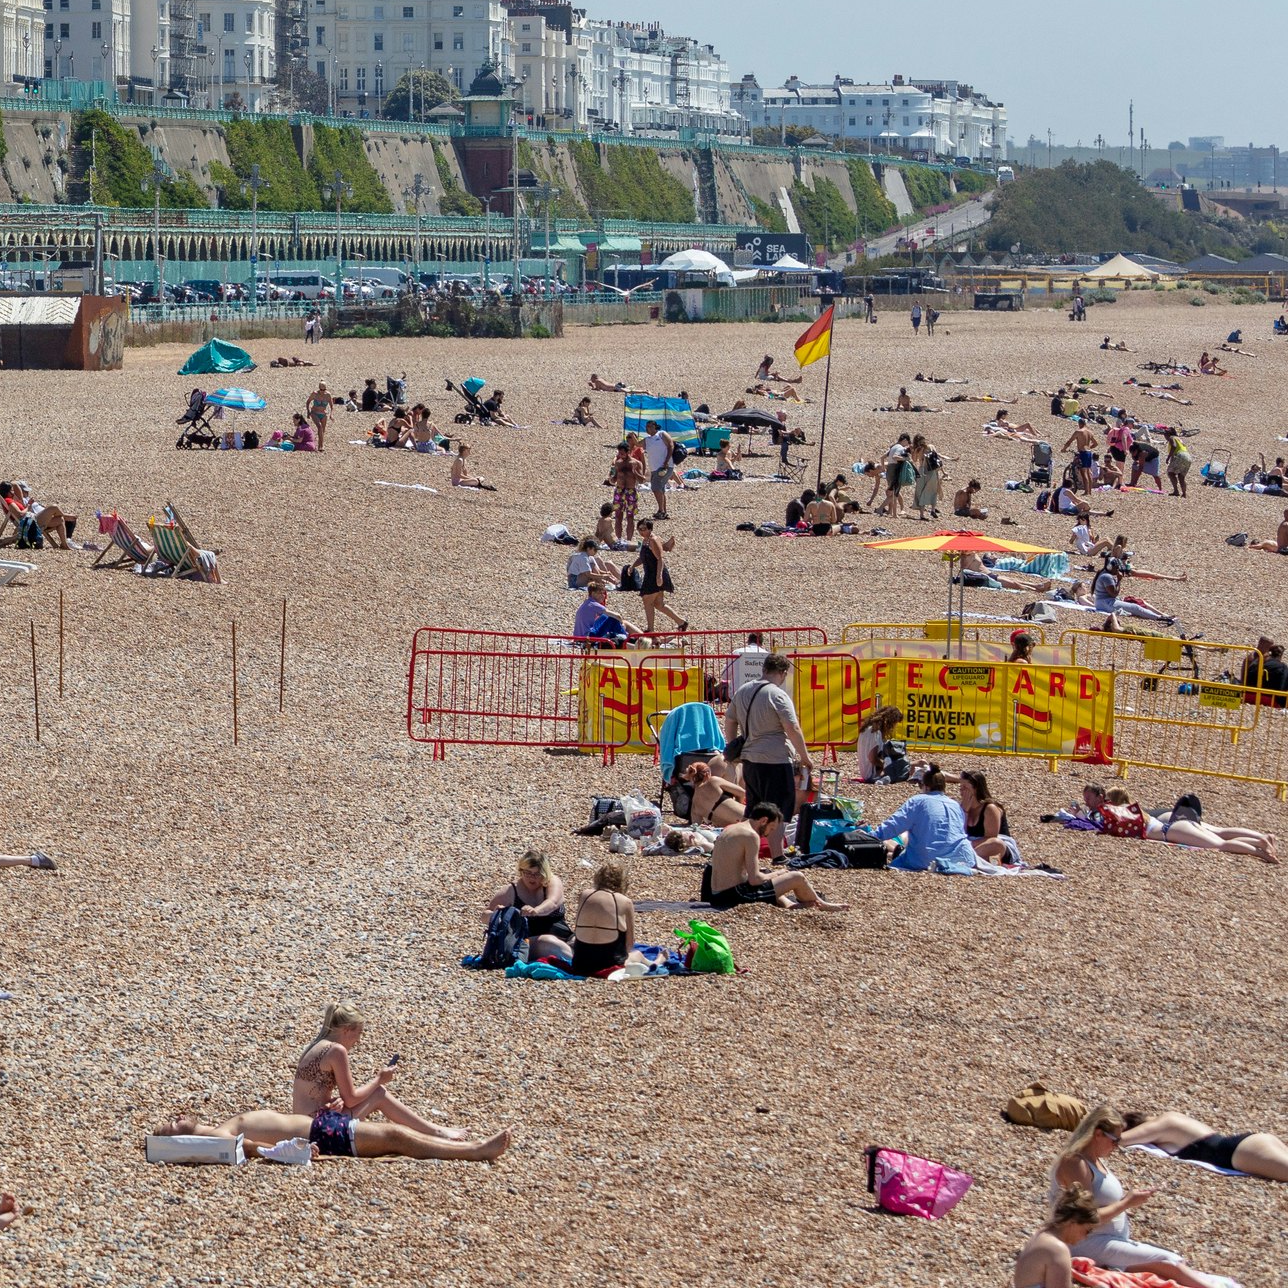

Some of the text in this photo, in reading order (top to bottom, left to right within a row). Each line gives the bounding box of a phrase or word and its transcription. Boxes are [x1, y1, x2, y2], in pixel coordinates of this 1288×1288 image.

[766, 244, 786, 253] SEA
[766, 252, 799, 261] LANS
[1204, 687, 1238, 697] CAUTION!
[907, 693, 953, 710] SWIM
[906, 710, 975, 727] BETWEEN
[906, 724, 957, 741] FLAGS
